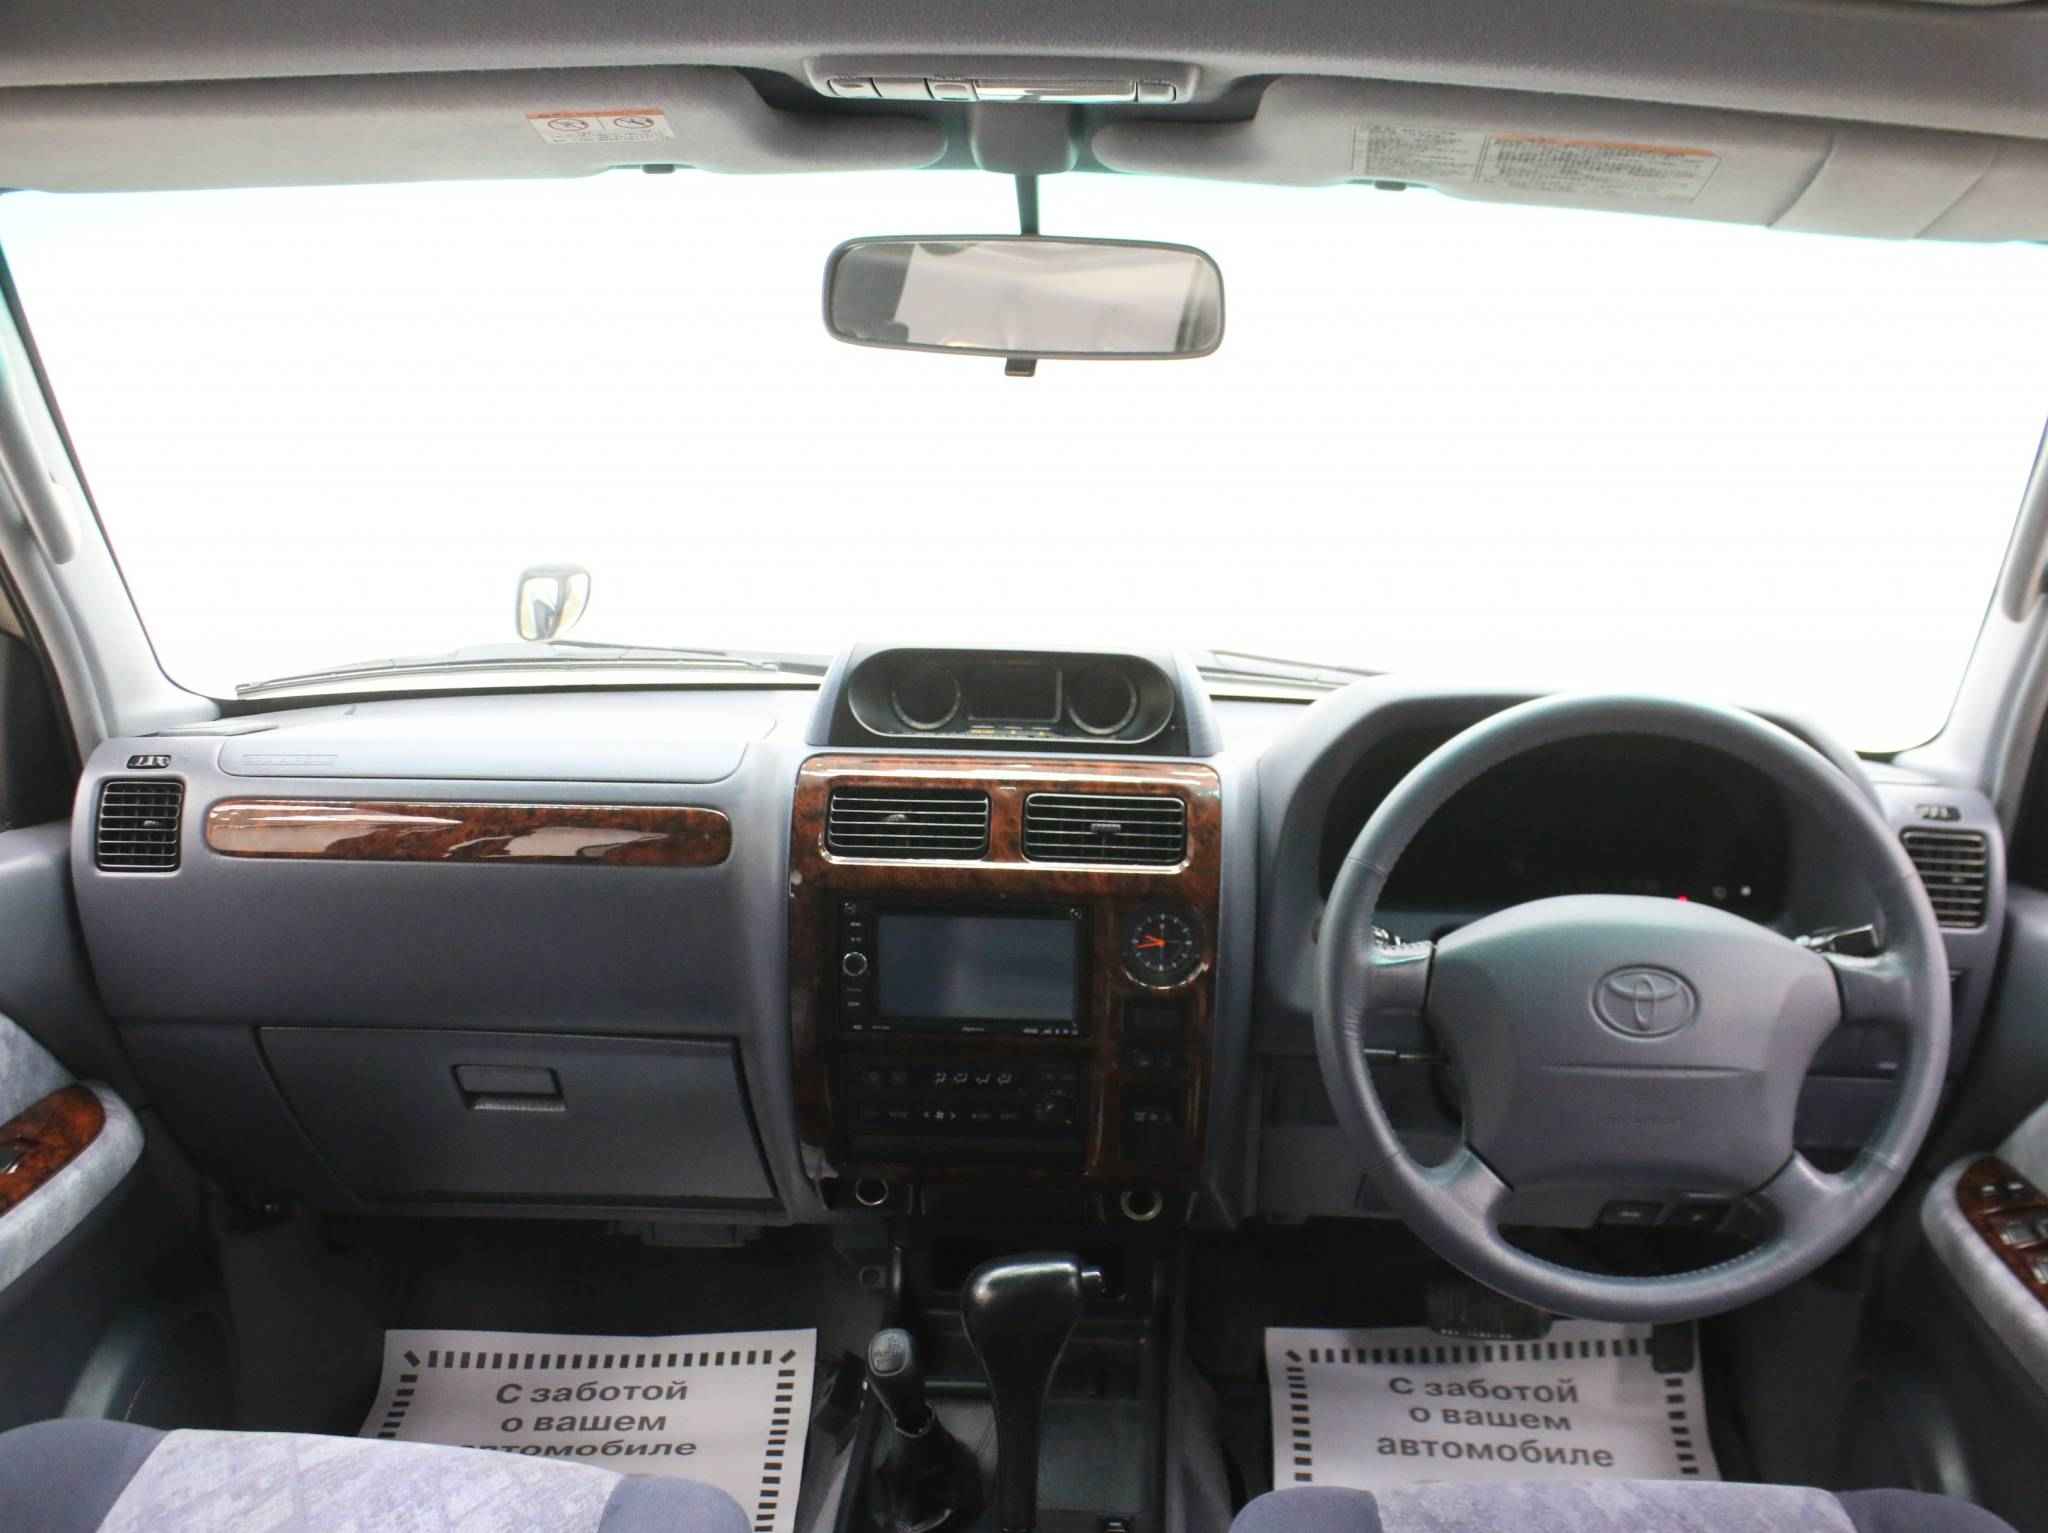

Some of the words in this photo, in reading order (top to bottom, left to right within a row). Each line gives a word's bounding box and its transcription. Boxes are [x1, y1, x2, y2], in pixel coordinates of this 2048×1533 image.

[496, 1383, 523, 1404] С
[530, 1380, 688, 1403] заботой
[1389, 1377, 1415, 1395] С
[1424, 1378, 1579, 1403] заботой
[501, 1417, 523, 1433] о
[533, 1415, 665, 1432] вашем
[1409, 1407, 1431, 1423] о
[1441, 1408, 1572, 1431] вашем
[461, 1440, 697, 1457] томобиле
[1377, 1437, 1615, 1467] автомобиле
